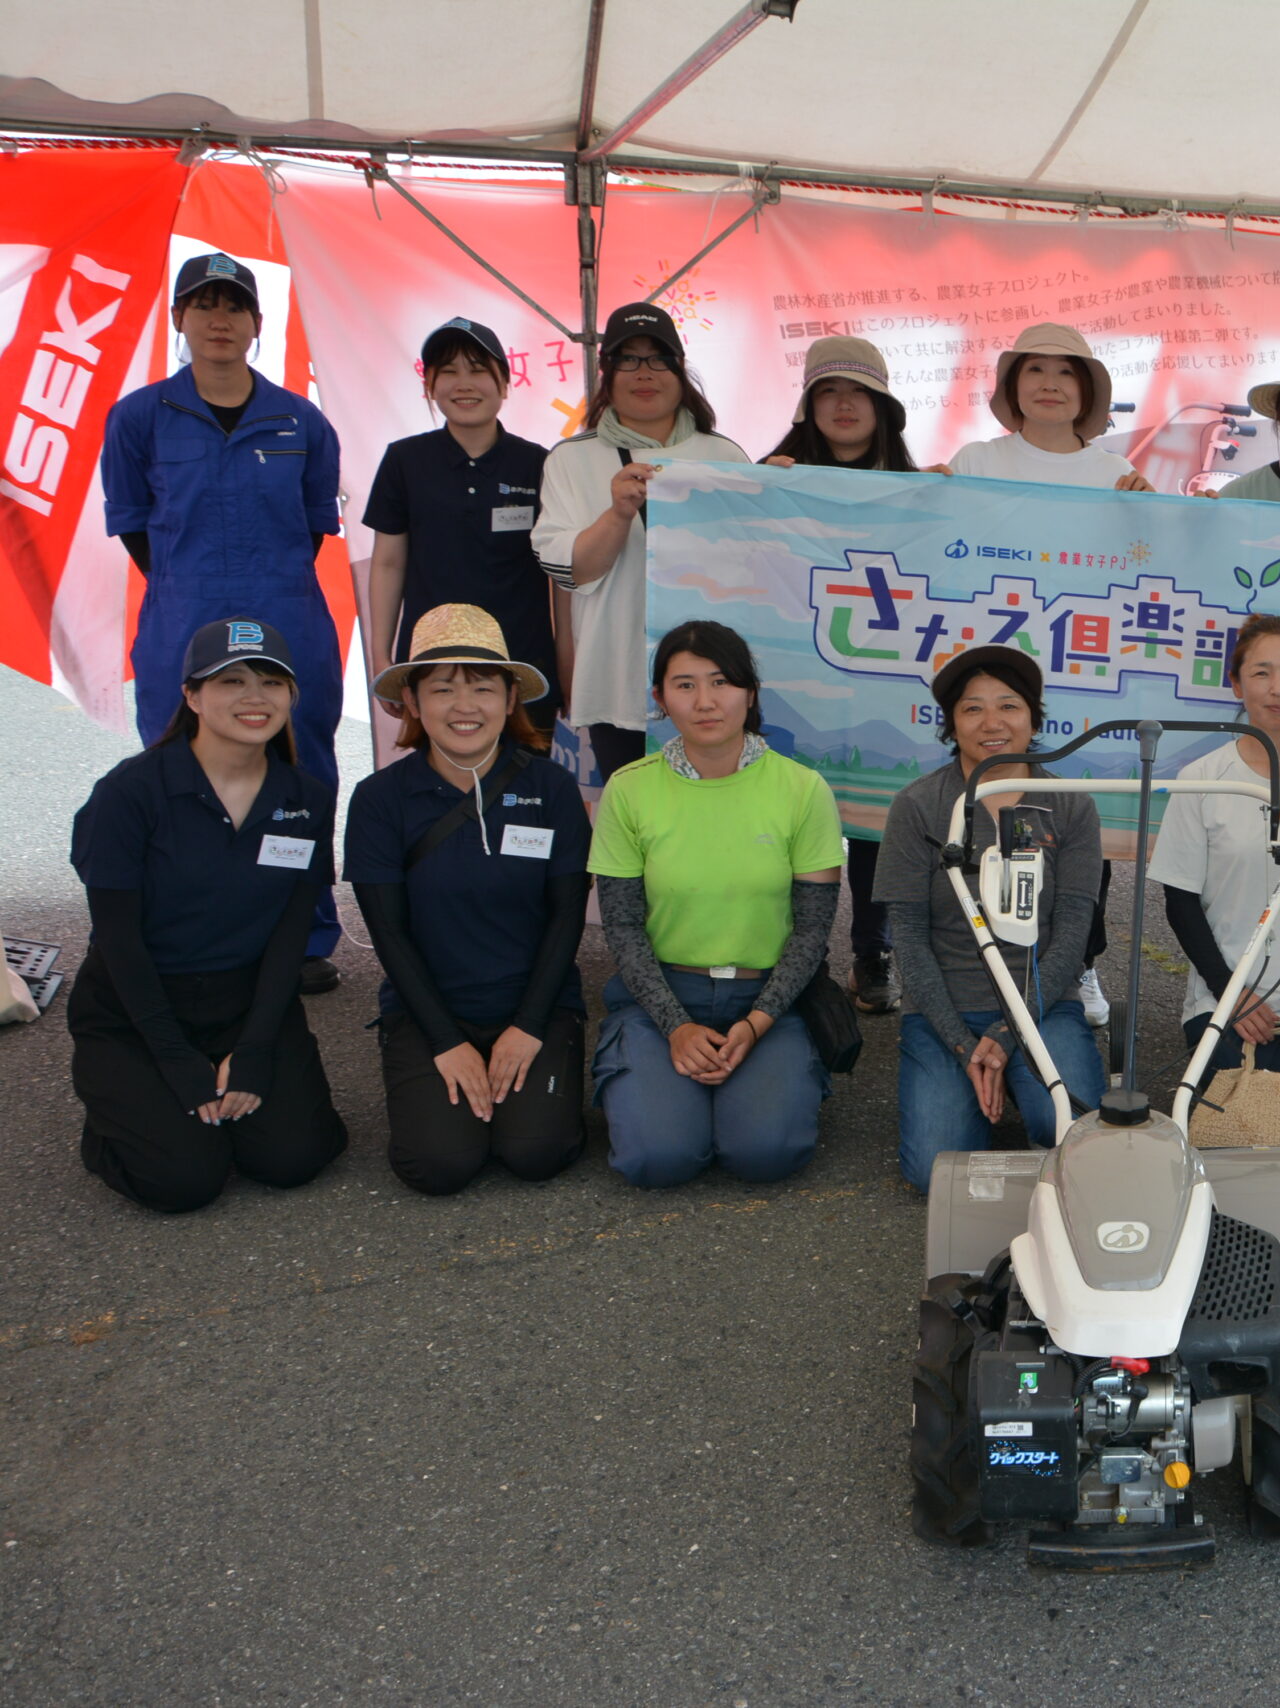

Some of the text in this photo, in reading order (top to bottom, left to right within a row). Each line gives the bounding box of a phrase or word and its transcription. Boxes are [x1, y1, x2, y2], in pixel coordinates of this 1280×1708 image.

[773, 269, 1090, 311] 農林水産省が推進する、農業女子プロジェクト。
[0, 253, 131, 517] ISEKI
[976, 545, 1032, 561] ISEKI
[1059, 551, 1126, 570] 農業女子PJ
[989, 1452, 1060, 1465] クイックスタート
